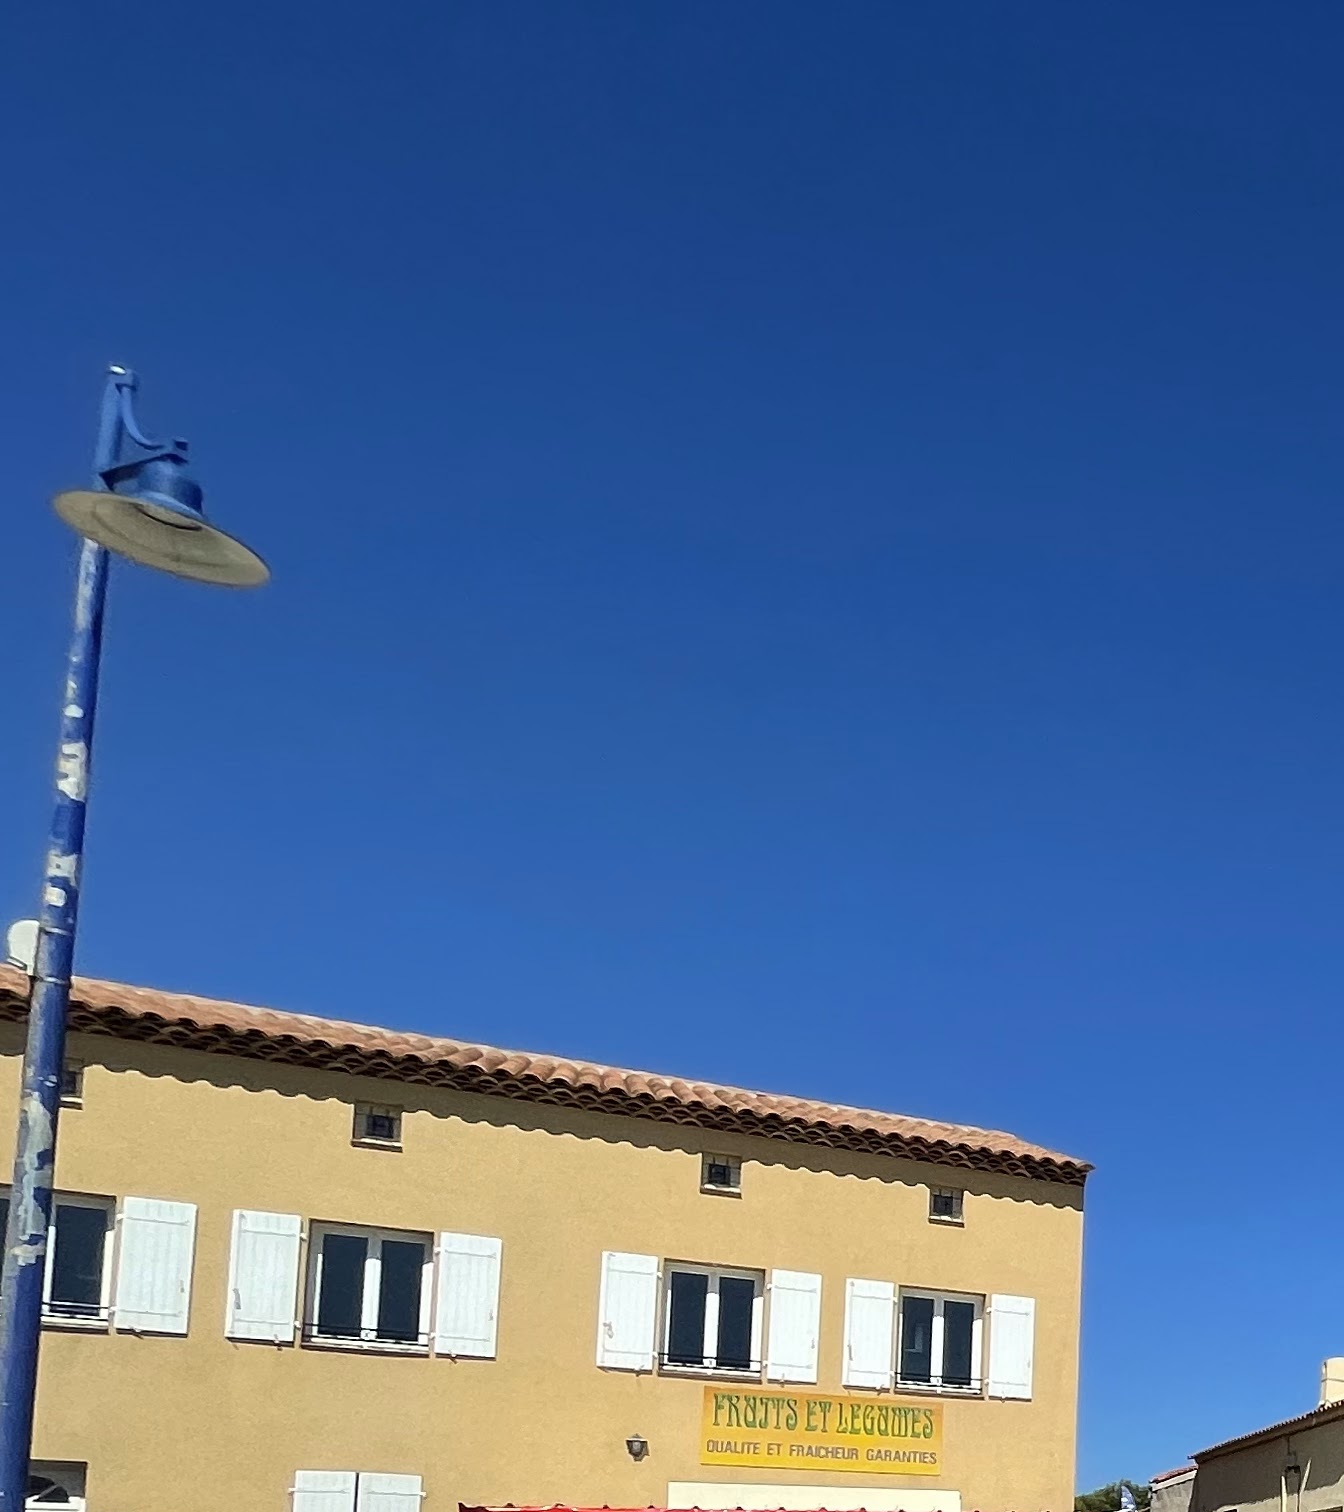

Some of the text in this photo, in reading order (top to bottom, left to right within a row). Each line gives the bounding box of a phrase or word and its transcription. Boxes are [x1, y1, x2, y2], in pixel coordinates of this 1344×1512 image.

[713, 1393, 934, 1439] FRUITS ET LEGUMES
[706, 1439, 937, 1465] QUALITE ET FRAICHEUR GARANTIES
